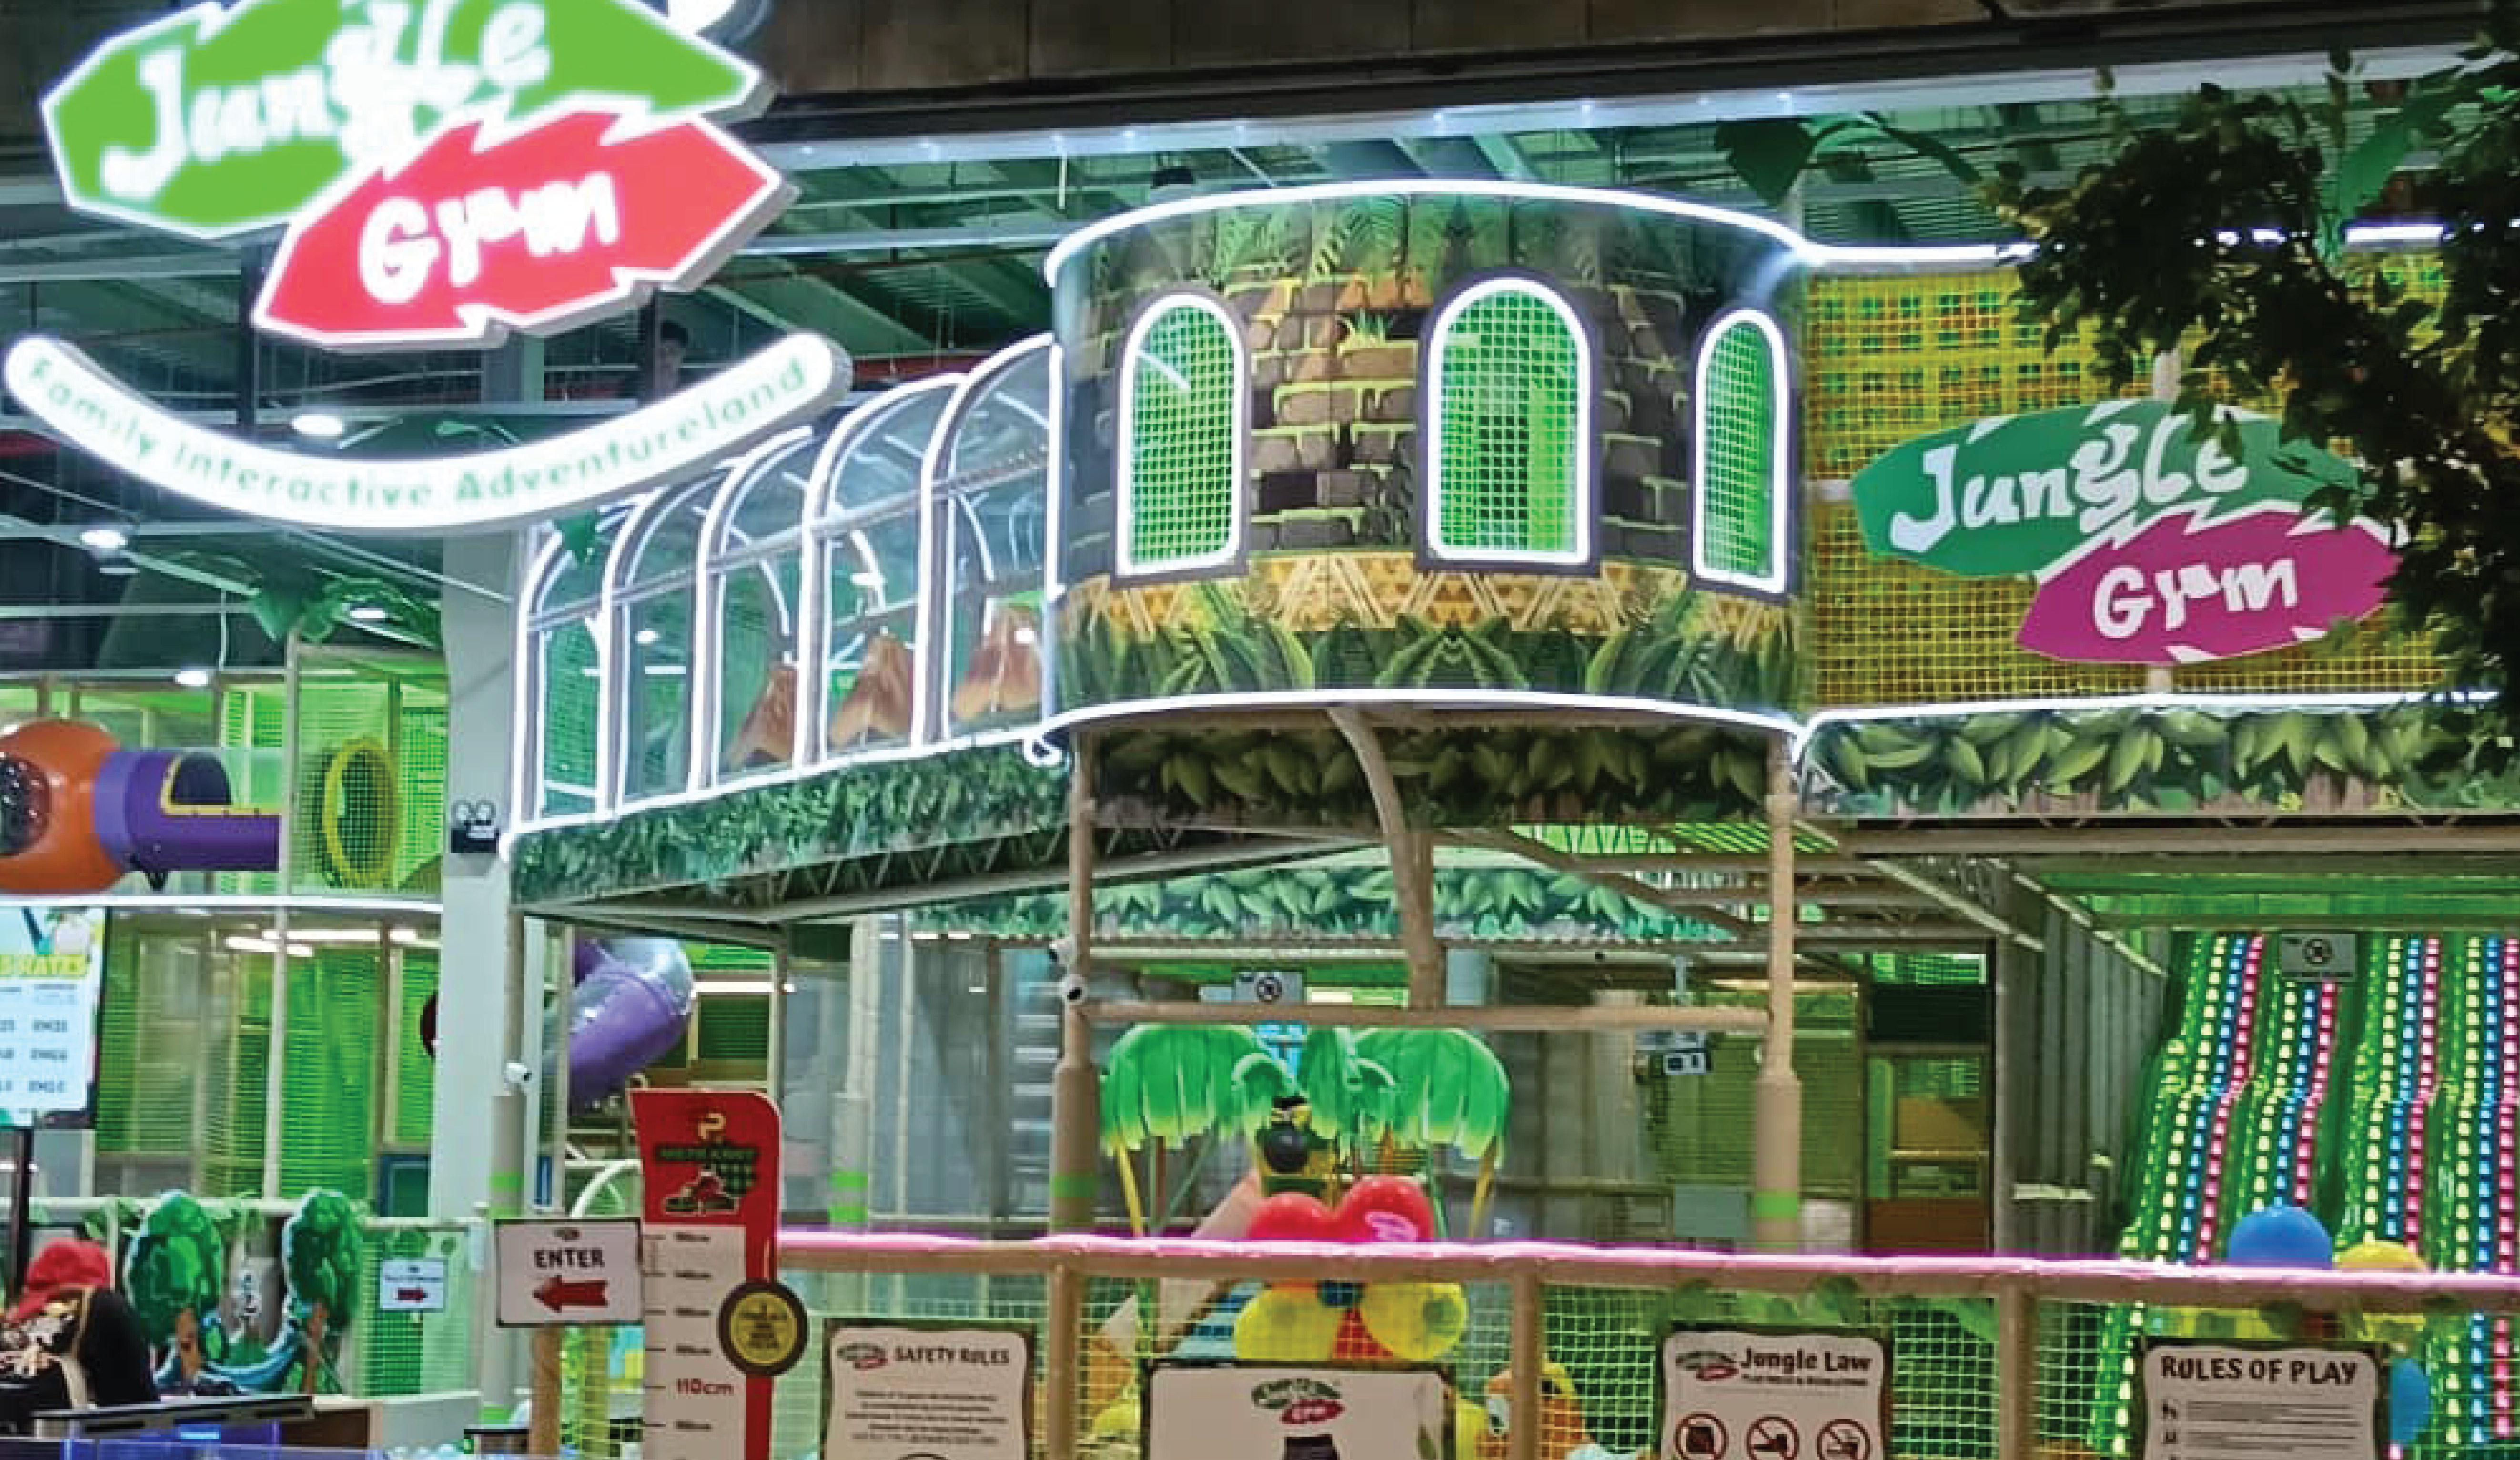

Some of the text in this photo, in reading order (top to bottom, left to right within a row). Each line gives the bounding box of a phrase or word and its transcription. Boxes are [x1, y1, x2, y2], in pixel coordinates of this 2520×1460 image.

[99, 0, 551, 200] Jungle
[357, 171, 620, 305] Gym
[29, 356, 808, 507] Family Interactive Adventureland
[1889, 415, 2247, 553] Jungle
[2093, 558, 2297, 639] Gym
[534, 1247, 605, 1268] ENTER
[895, 1345, 954, 1364] SAFETY
[961, 1348, 1009, 1366] RULES
[1741, 1348, 1818, 1374] Jungle
[1824, 1351, 1873, 1371] Law
[2160, 1356, 2358, 1386] RULES OF PLAY
[677, 1378, 734, 1395] 110cm
